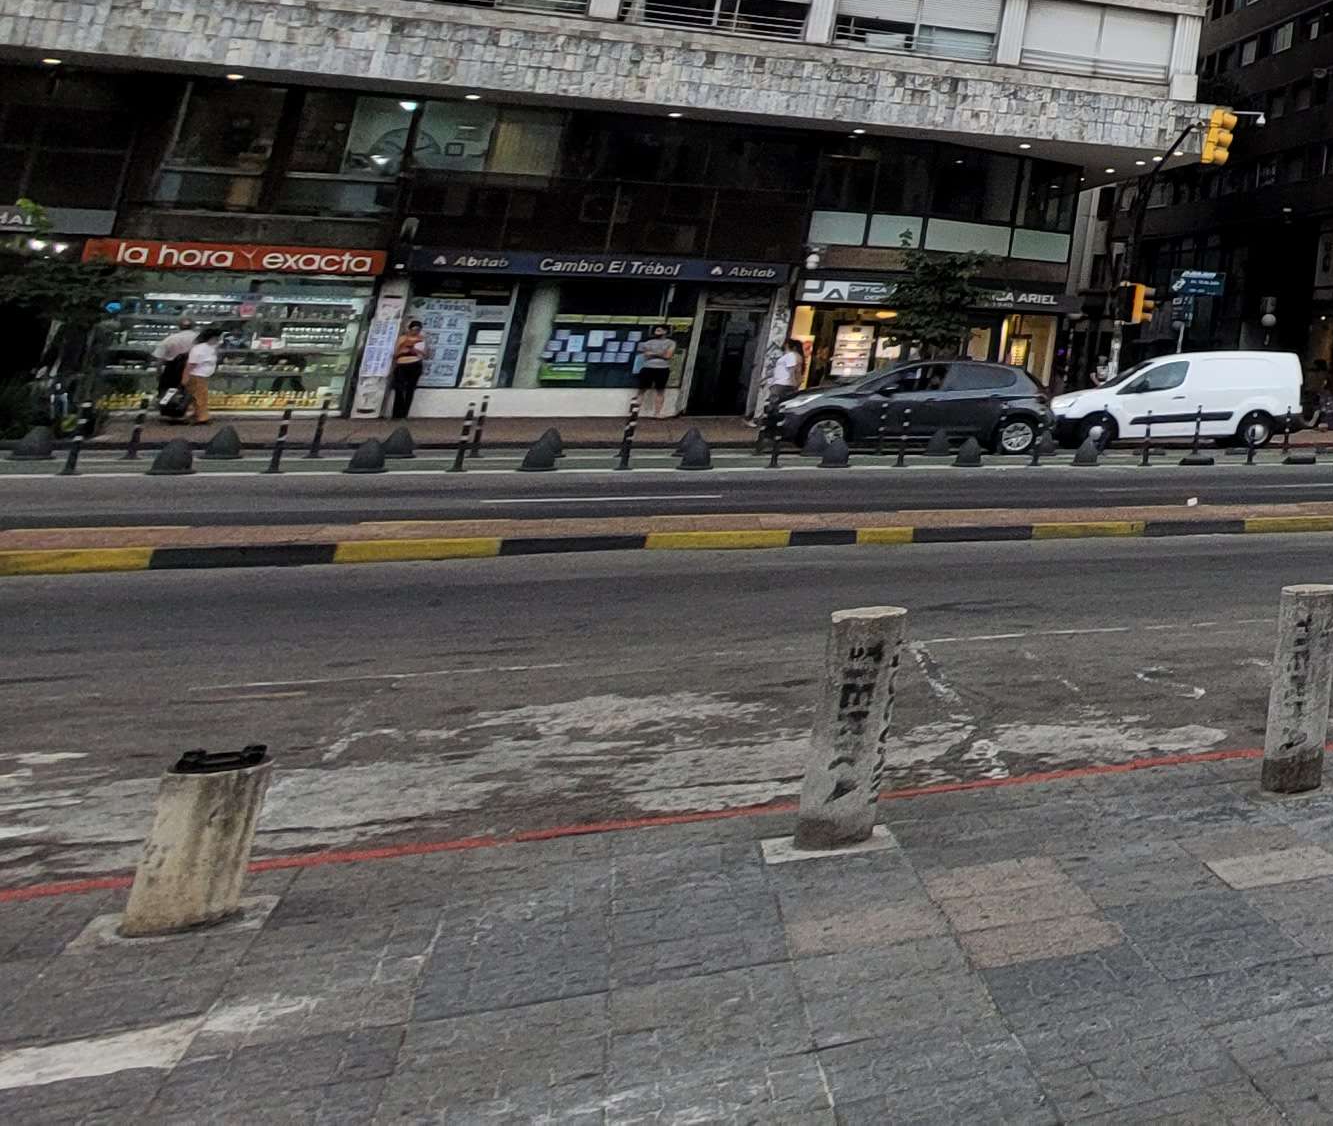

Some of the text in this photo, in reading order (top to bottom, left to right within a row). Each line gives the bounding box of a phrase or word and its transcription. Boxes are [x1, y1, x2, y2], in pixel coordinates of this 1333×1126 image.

[116, 242, 372, 272] la hora exacta
[454, 256, 509, 267] Abitab
[539, 258, 682, 276] Cambio El Trébol
[728, 266, 776, 278] Abitab
[1017, 293, 1058, 305] ARIEL
